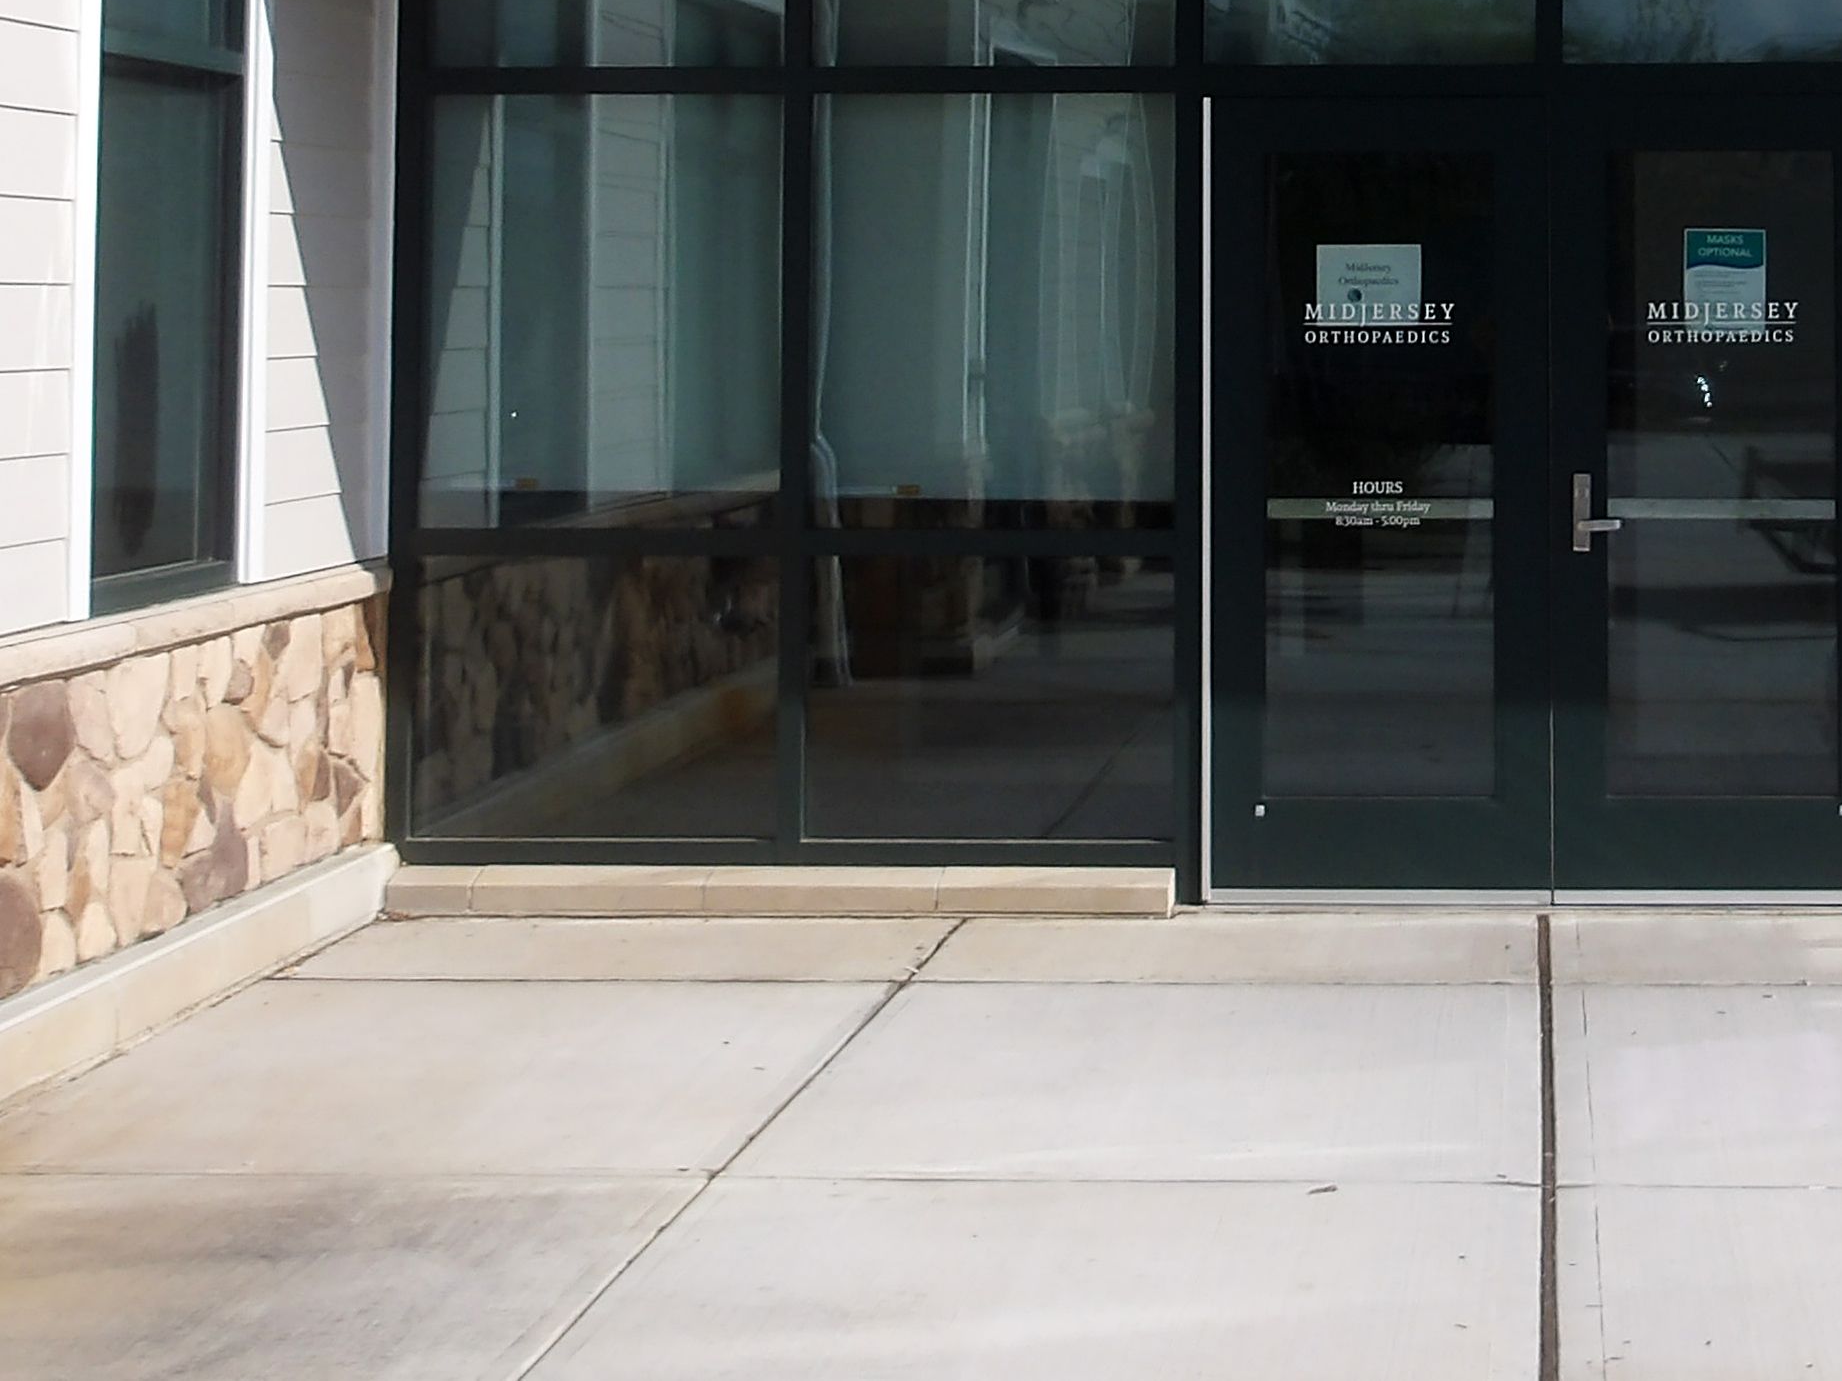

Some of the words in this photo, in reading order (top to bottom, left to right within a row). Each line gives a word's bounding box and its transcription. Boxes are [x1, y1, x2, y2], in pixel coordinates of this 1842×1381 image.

[1706, 234, 1744, 245] MASKS
[1697, 247, 1753, 258] OPTIONAL
[1338, 276, 1399, 287] Orthopaedics
[1304, 303, 1455, 327] MIDJERSEY
[1647, 302, 1799, 325] MIDJERSEY
[1304, 330, 1451, 344] ORTHOPAEDICS
[1647, 329, 1794, 343] ORTHOPAEDICS
[1352, 481, 1403, 494] HOURS
[1325, 501, 1369, 514] Monday
[1370, 500, 1395, 512] thru
[1396, 501, 1432, 514] Friday
